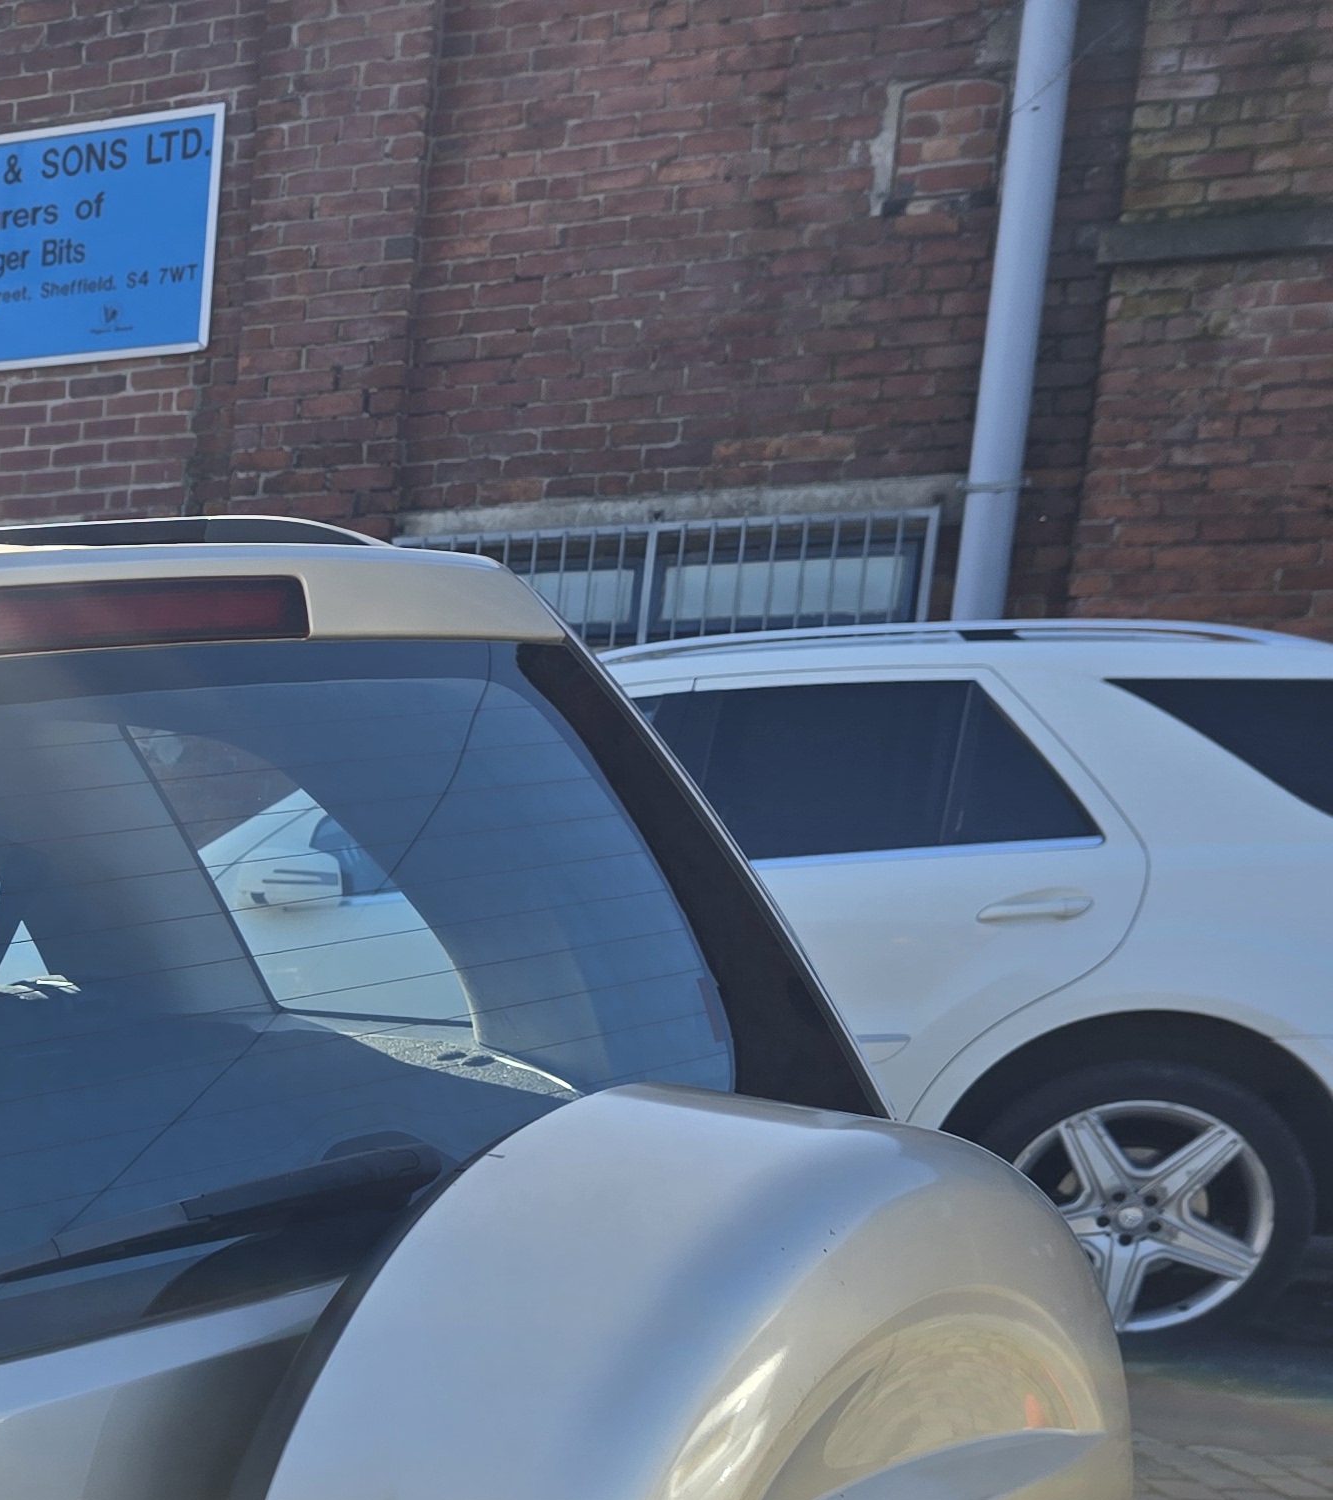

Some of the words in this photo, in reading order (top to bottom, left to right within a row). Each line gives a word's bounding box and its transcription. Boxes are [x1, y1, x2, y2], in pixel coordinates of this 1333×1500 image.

[2, 152, 24, 185] &
[40, 137, 129, 180] SONS
[144, 126, 213, 166] LTD.
[74, 191, 106, 221] of
[40, 238, 87, 268] Bits
[125, 269, 150, 290] S4
[157, 263, 199, 286] 7WT
